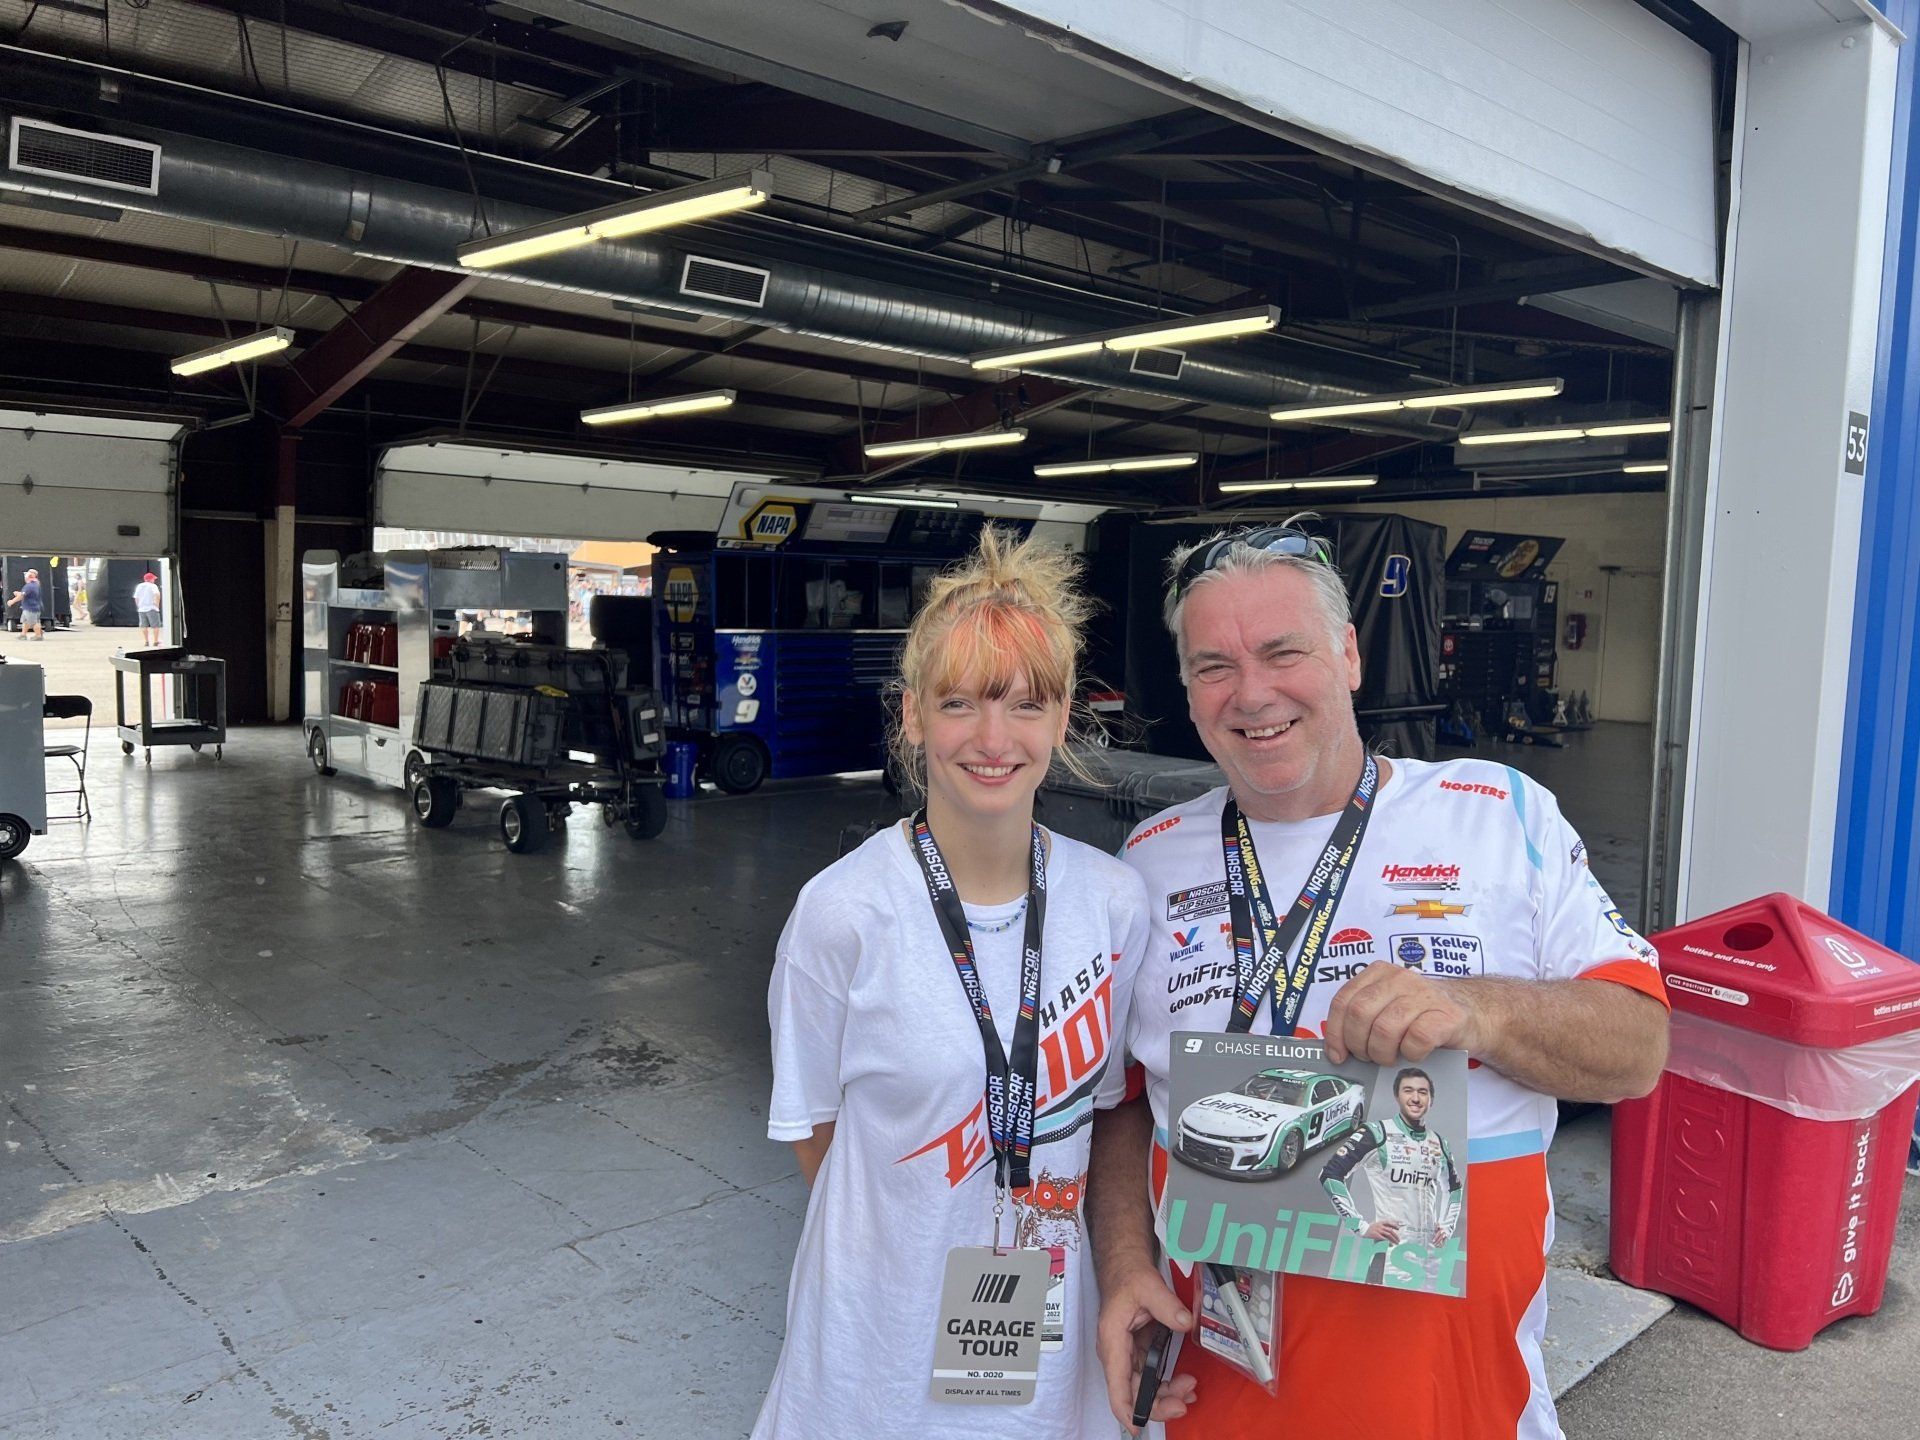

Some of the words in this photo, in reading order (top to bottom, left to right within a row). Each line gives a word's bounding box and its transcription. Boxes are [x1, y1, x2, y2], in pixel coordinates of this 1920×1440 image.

[1848, 425, 1866, 462] 53
[757, 515, 790, 534] NAPA
[1380, 554, 1411, 597] 9
[734, 699, 760, 723] 9
[1440, 780, 1506, 800] HOOTERS
[1126, 816, 1181, 850] HOOTERS
[919, 838, 952, 890] NASCAR
[1034, 834, 1045, 890] NASCAR
[1226, 852, 1245, 896] NASCAR
[1307, 845, 1341, 894] NASCAR
[1381, 864, 1460, 882] Hendrick
[1177, 901, 1195, 914] CUP
[1195, 895, 1227, 909] SERIES
[1189, 884, 1226, 899] NASCAR
[1193, 906, 1226, 918] CHAMPION
[1170, 941, 1204, 962] VALVOLINE
[1430, 936, 1477, 952] Kelley
[1433, 949, 1467, 961] Blue
[1434, 961, 1471, 976] Book
[1683, 944, 1714, 957] bottles
[1714, 953, 1733, 962] and
[1733, 958, 1755, 967] cans
[1756, 963, 1776, 972] only
[1168, 962, 1236, 993] UniFirs
[1247, 947, 1283, 1000] NASCAR
[1292, 965, 1309, 991] MIS
[1039, 952, 1105, 1029] HASE
[1170, 985, 1233, 1013] GOODYE
[1184, 1038, 1203, 1053] 9
[1215, 1042, 1261, 1056] CHASE
[1265, 1045, 1323, 1059] ELLIOTT
[990, 1075, 1003, 1136] NASCAR
[1006, 1072, 1024, 1133] NASCAR
[1199, 1097, 1280, 1122] UniFirst
[1325, 1099, 1351, 1122] UniFirst
[1308, 1111, 1324, 1139] 9
[1852, 1127, 1870, 1187] back.
[1849, 1193, 1861, 1210] it
[1166, 1199, 1467, 1293] UniFirst
[1843, 1216, 1858, 1263] give
[946, 1319, 1036, 1337] GARAGE
[959, 1339, 1019, 1357] TOUR
